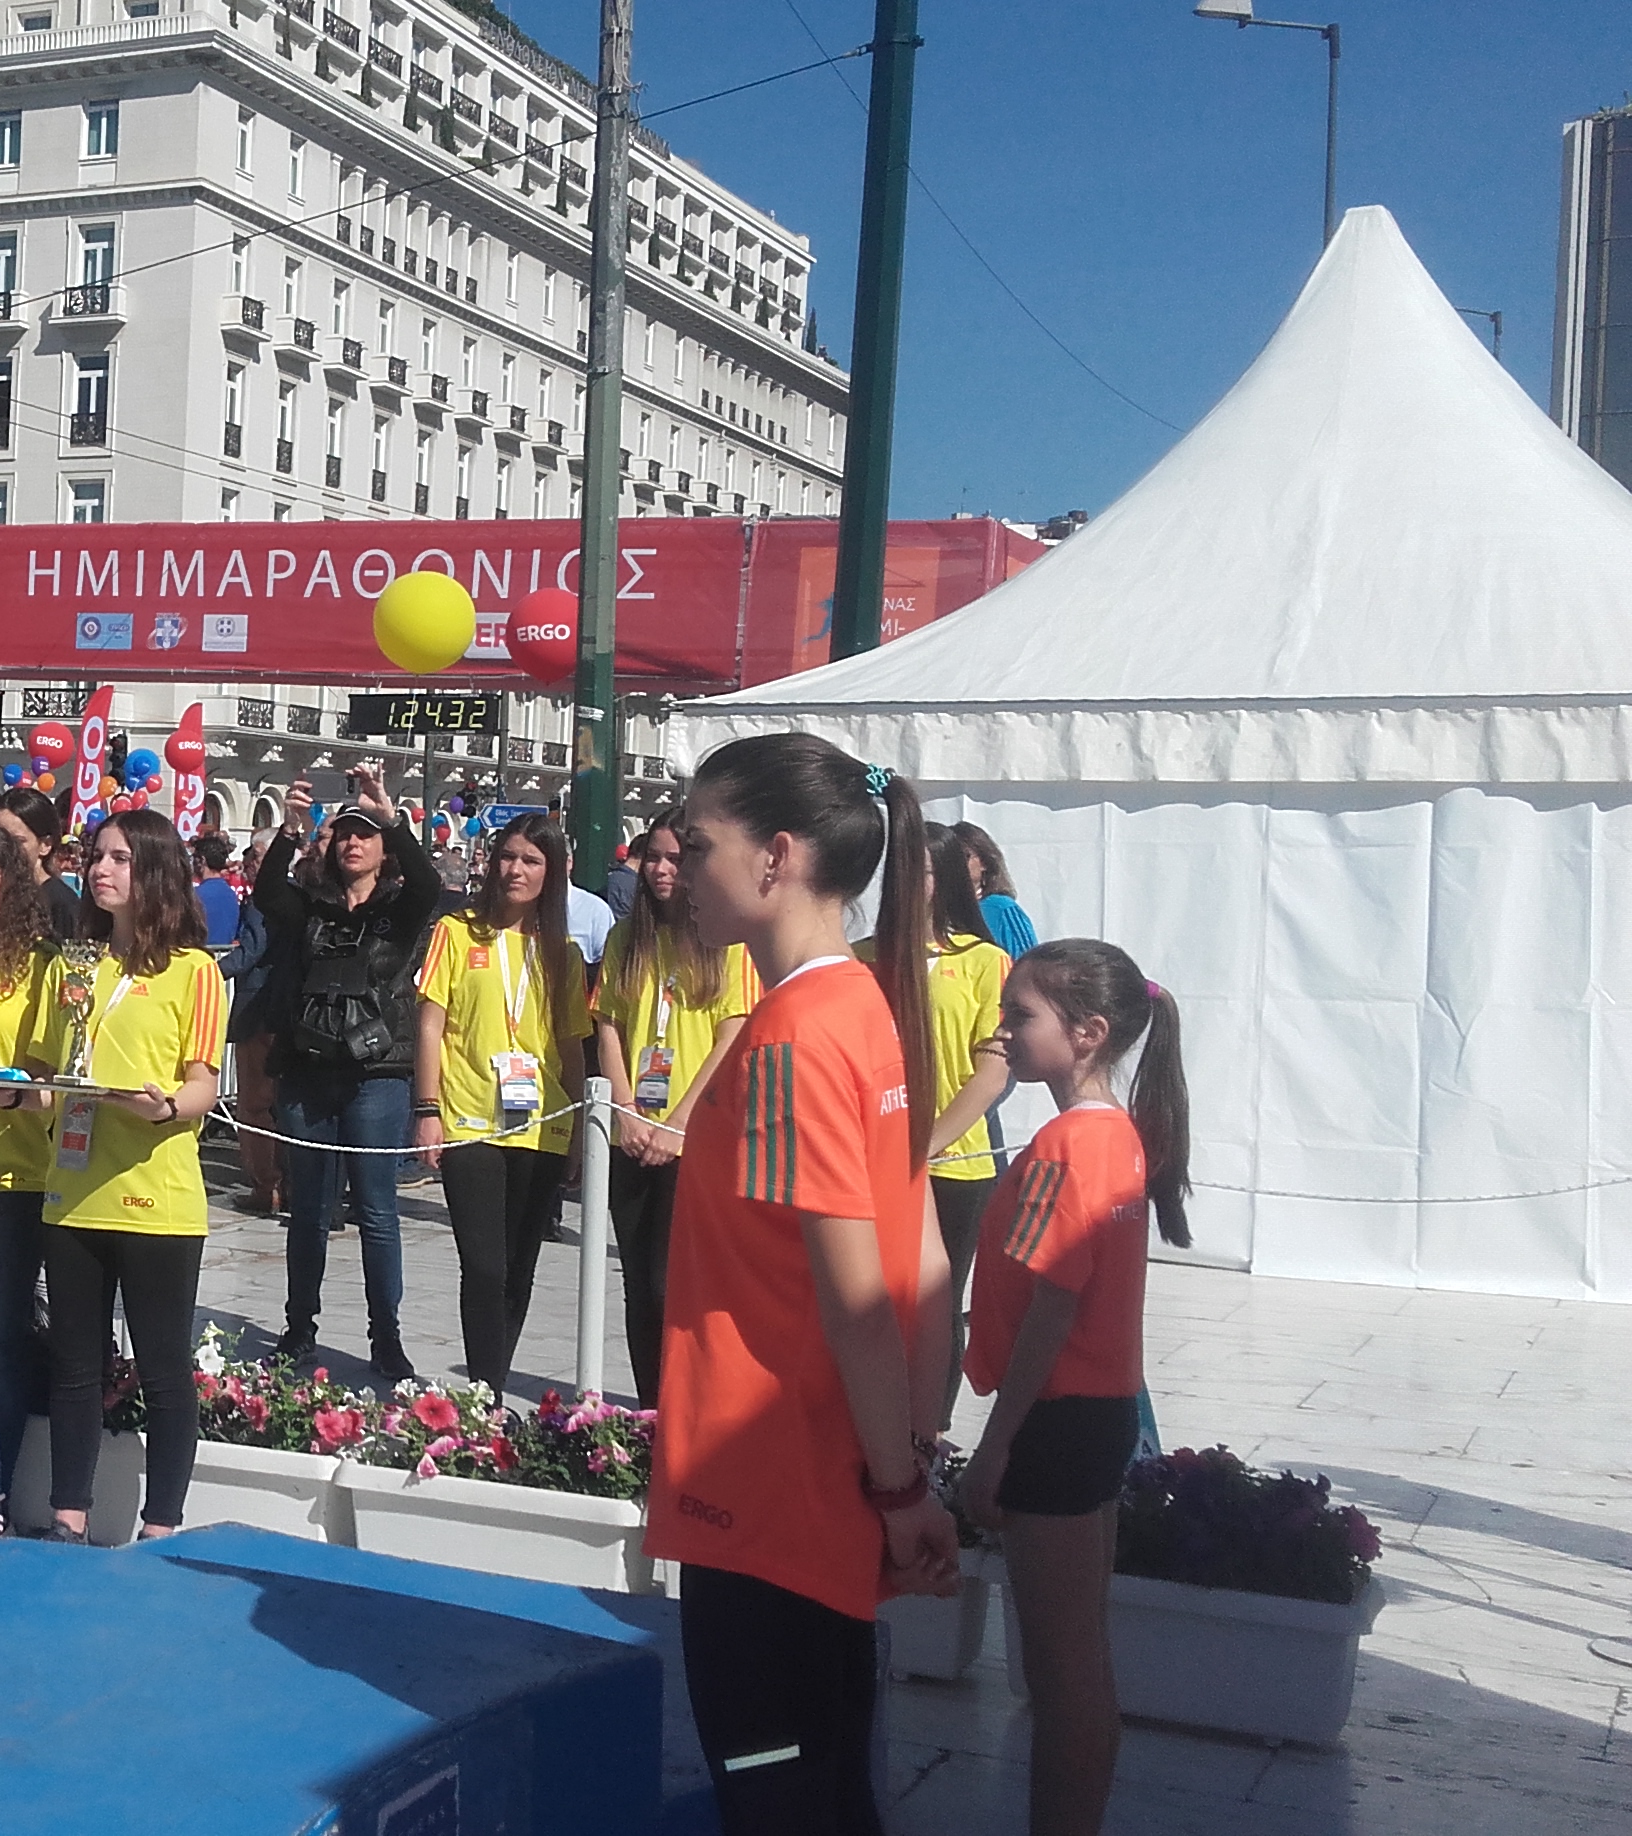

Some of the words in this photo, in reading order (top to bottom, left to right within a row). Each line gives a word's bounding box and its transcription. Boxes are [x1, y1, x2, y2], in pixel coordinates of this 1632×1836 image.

[883, 597, 916, 612] ΝΑΣ
[475, 622, 506, 648] ER
[517, 623, 570, 642] ERGO
[36, 735, 63, 749] ERGO
[178, 741, 203, 750] ERGO
[123, 1196, 155, 1208] ERGO
[678, 1493, 733, 1530] ERGO
